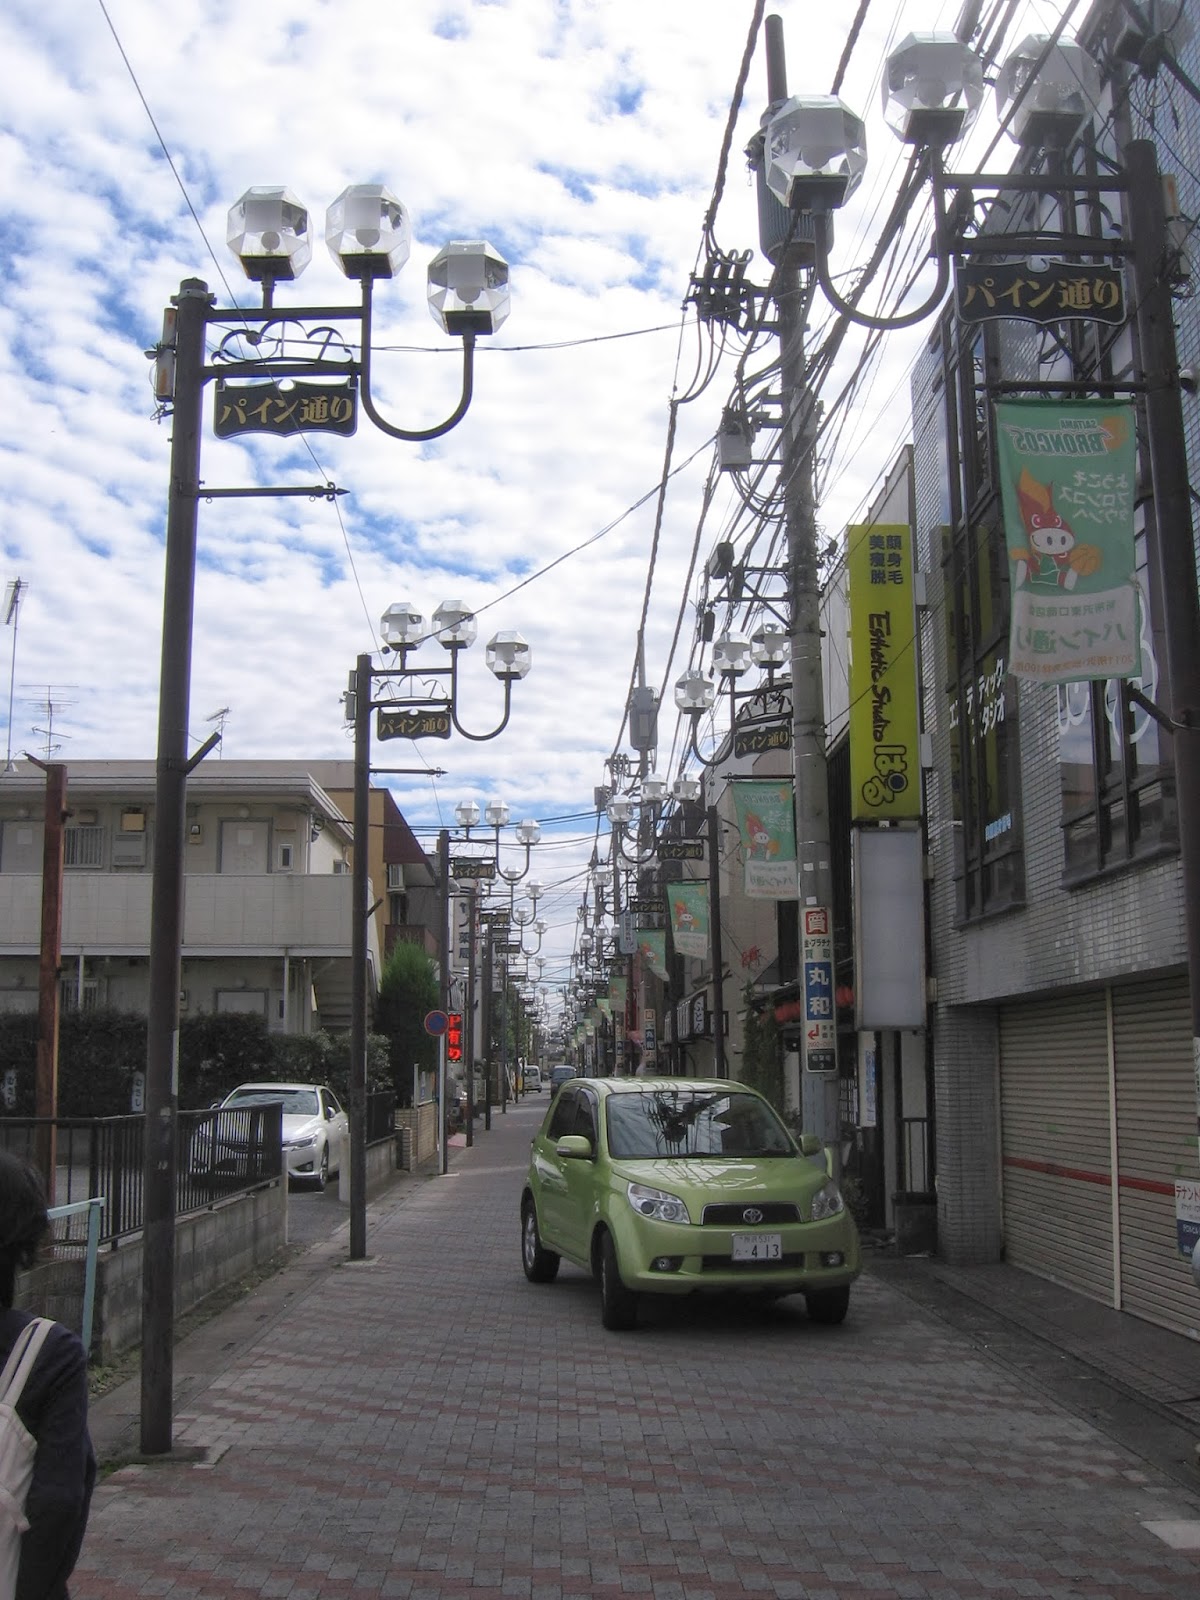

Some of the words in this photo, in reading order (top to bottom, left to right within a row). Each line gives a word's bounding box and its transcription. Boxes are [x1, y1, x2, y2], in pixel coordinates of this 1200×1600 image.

[963, 277, 1119, 310] パイン通り
[219, 395, 352, 425] パイン通り
[871, 569, 903, 585] 脱毛
[868, 611, 892, 683] Esthetic
[380, 717, 449, 734] パイン通り
[871, 683, 892, 743] Studio
[736, 731, 788, 752] パイン通り
[809, 966, 830, 1016] 丸和
